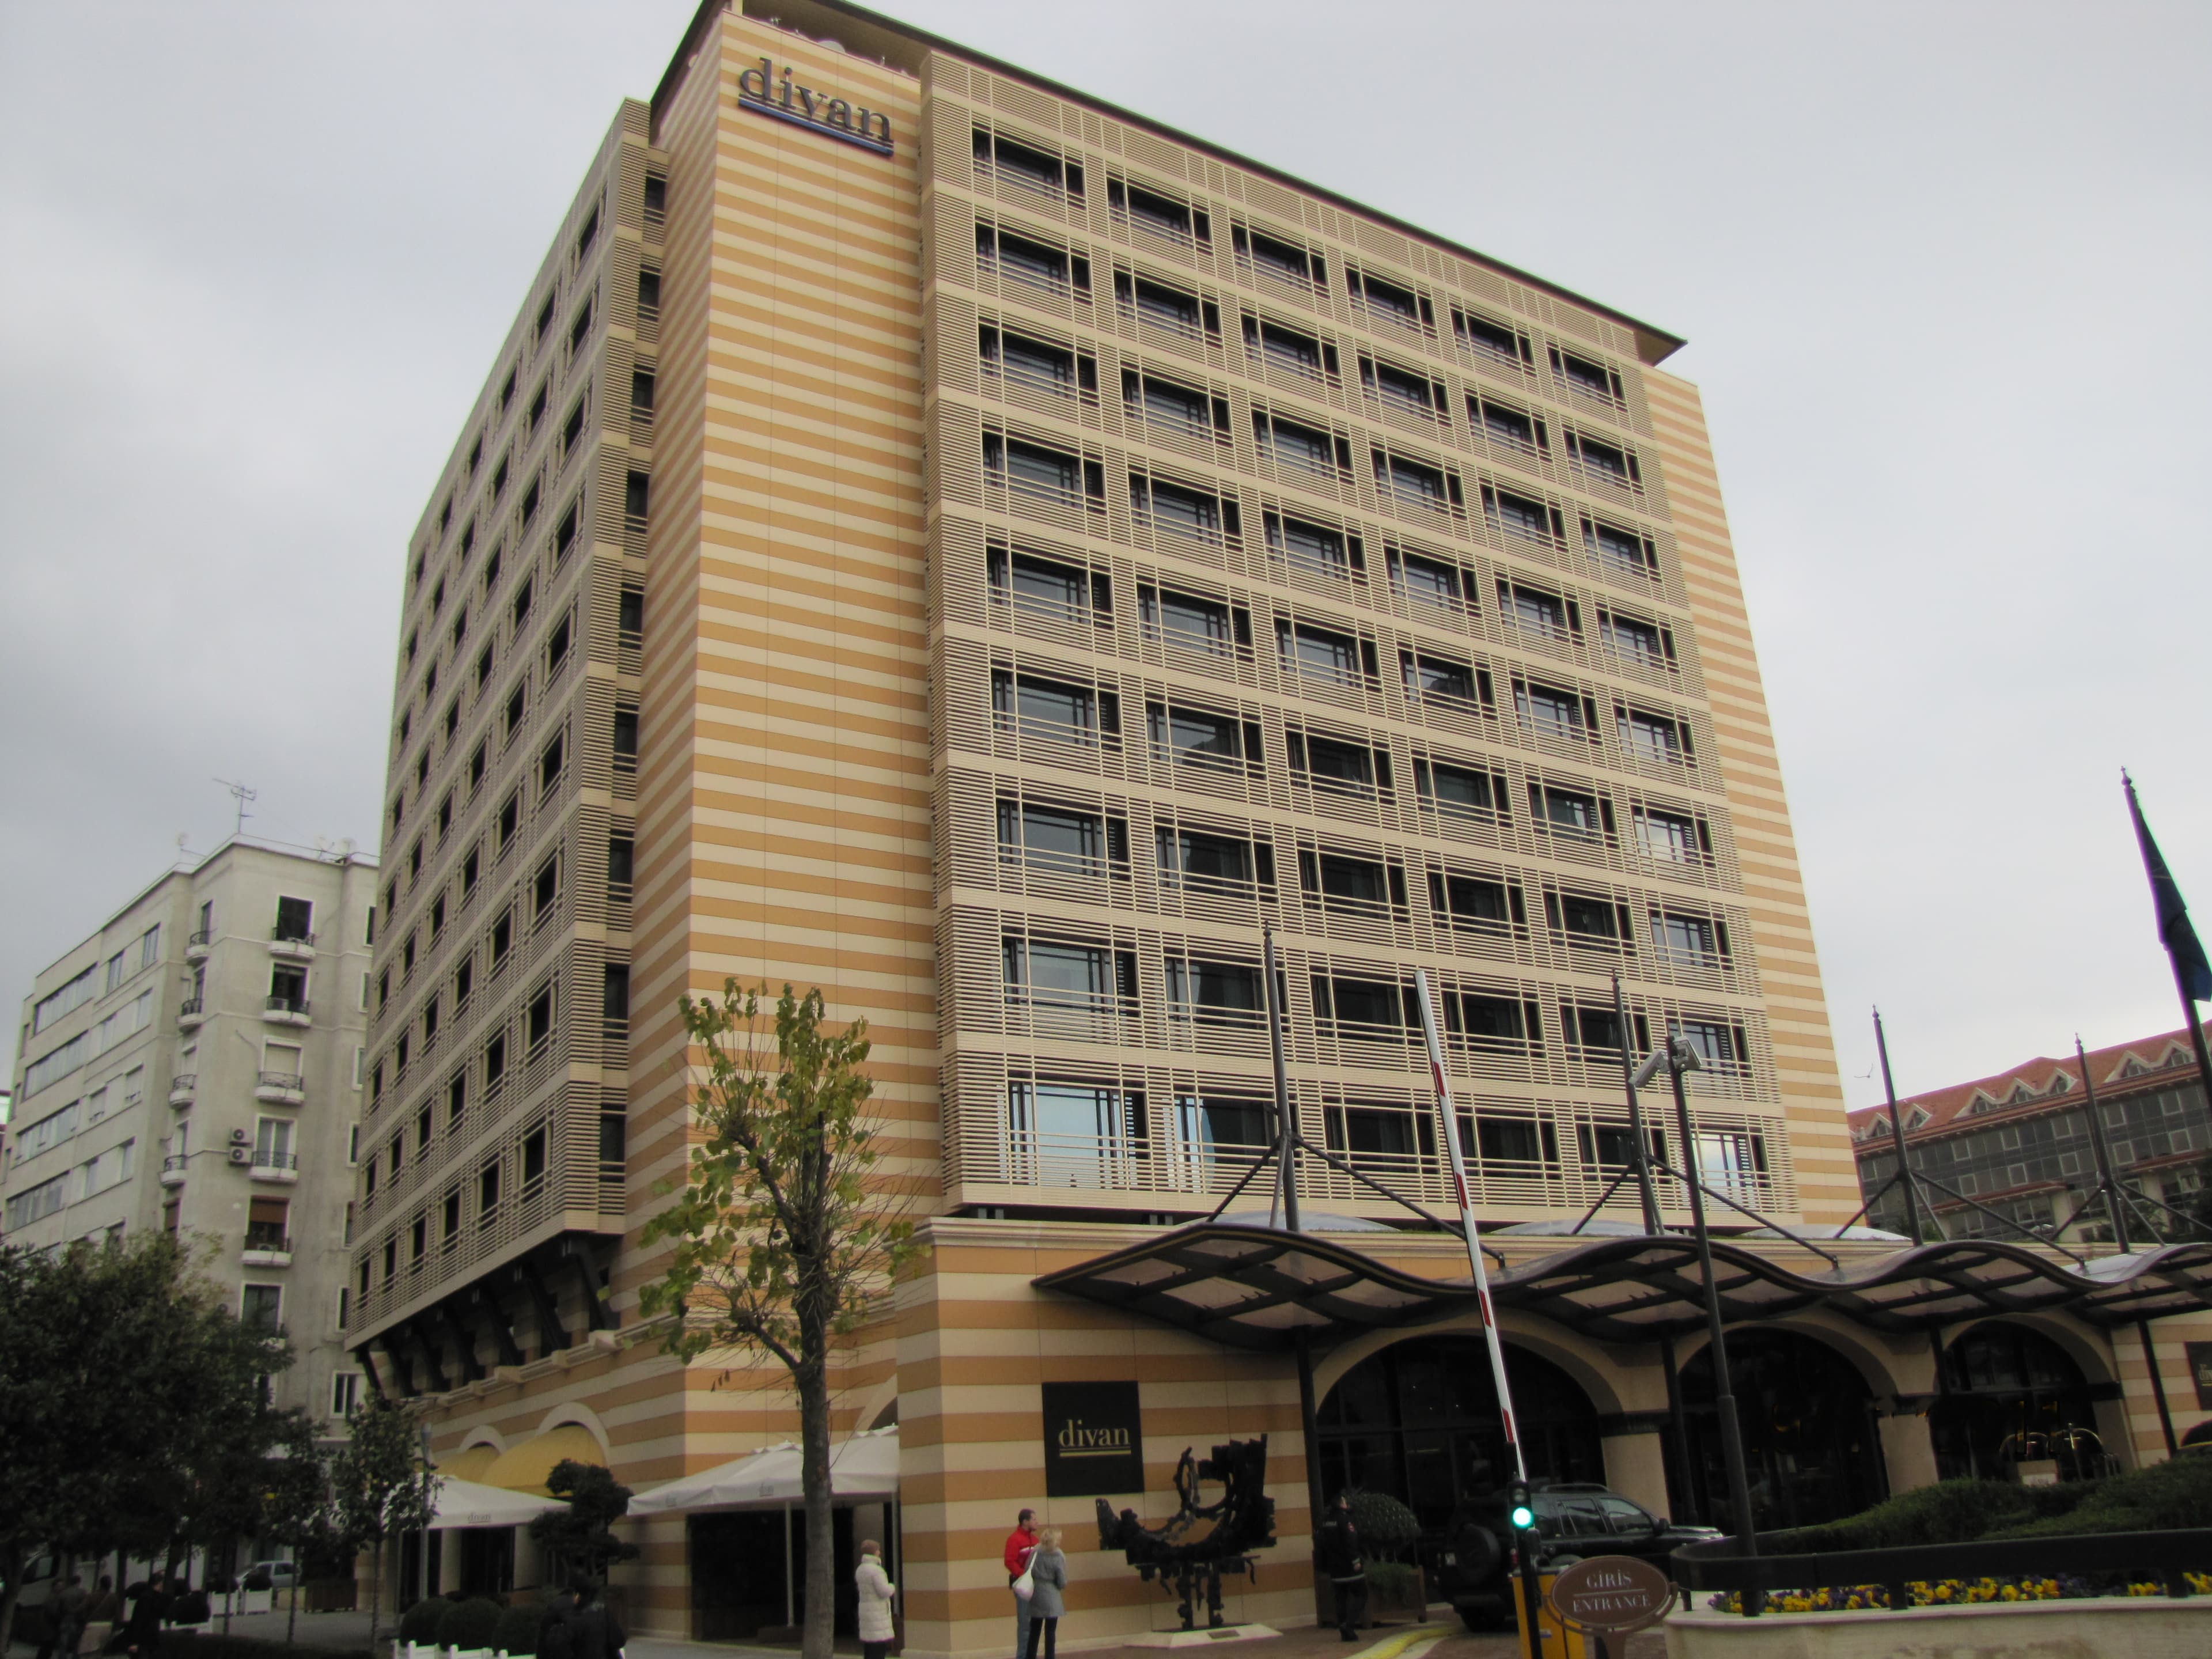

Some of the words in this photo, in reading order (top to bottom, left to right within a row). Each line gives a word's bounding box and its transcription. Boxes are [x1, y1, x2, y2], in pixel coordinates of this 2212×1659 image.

[740, 56, 892, 143] divan
[1058, 1419, 1130, 1447] divan
[1573, 1594, 1651, 1612] ENTRANCE
